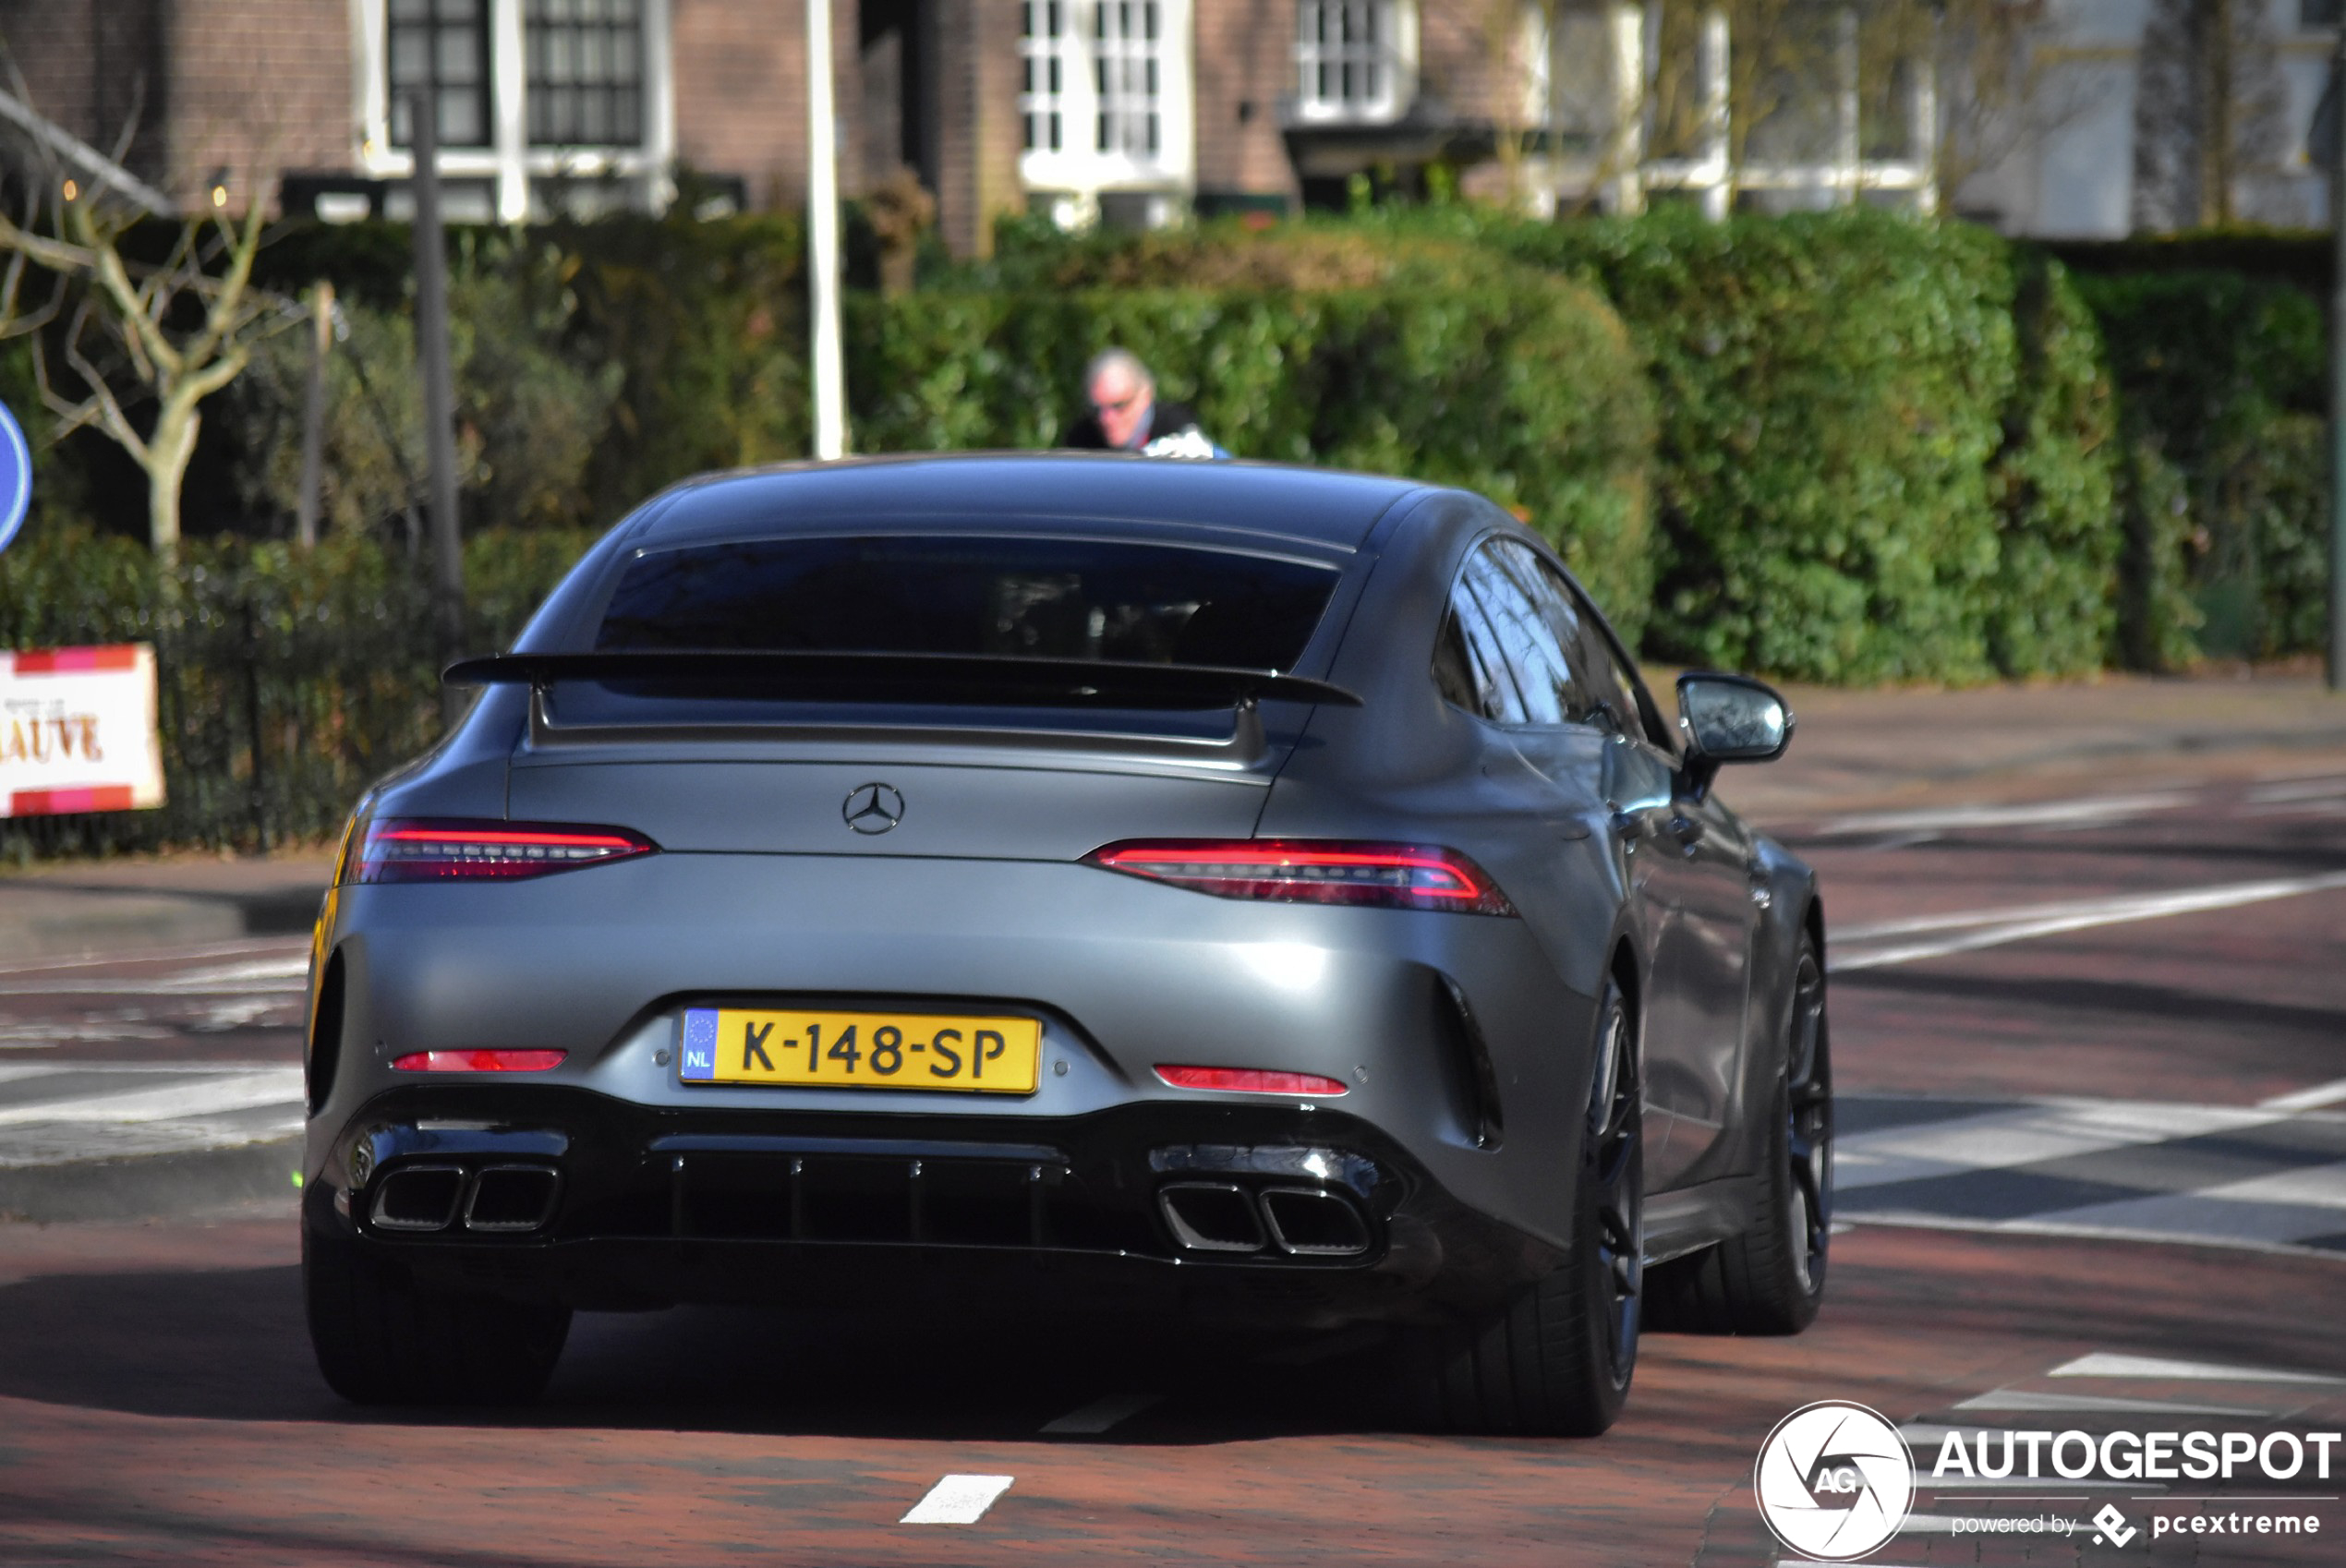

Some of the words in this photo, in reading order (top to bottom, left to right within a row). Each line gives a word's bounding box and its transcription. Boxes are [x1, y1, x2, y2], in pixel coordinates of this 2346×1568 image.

[0, 712, 103, 764] AUVE
[687, 1051, 710, 1067] NL
[743, 1020, 1005, 1079] K-148-SP
